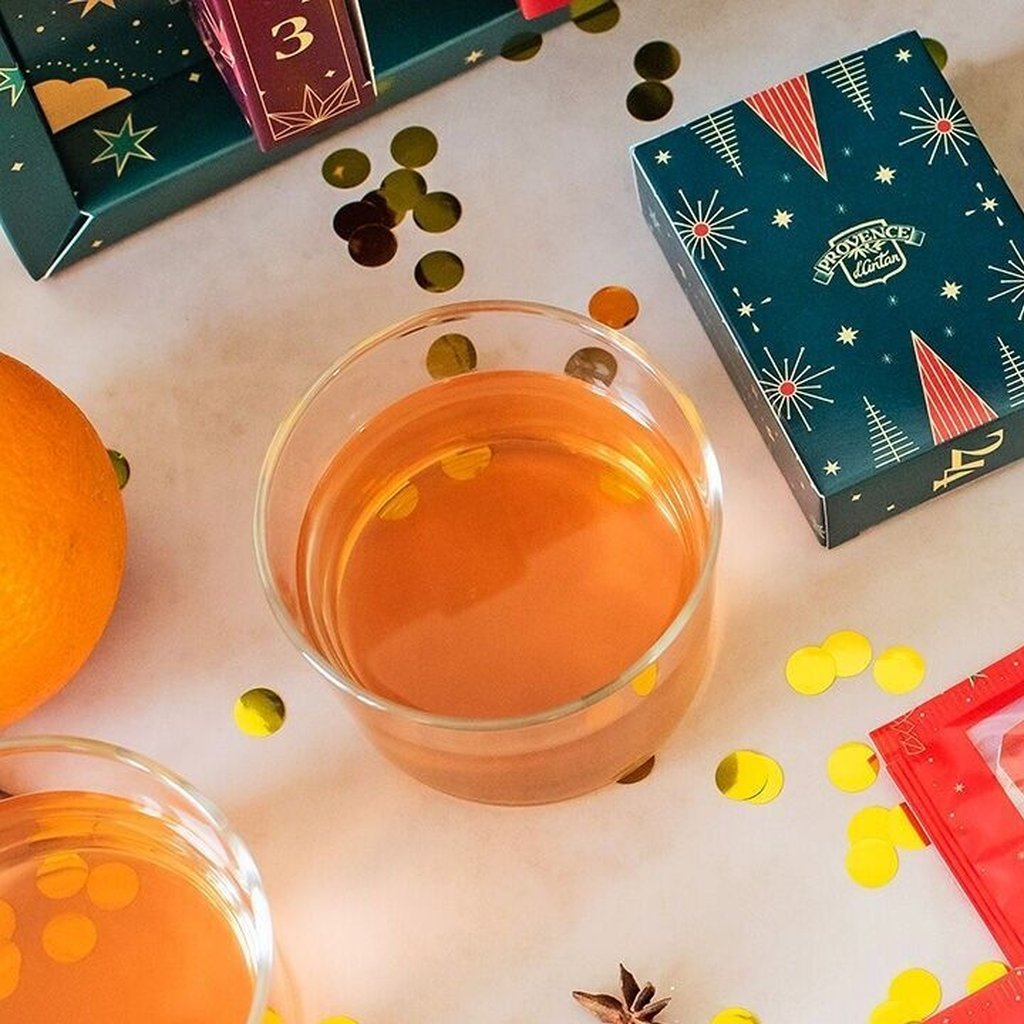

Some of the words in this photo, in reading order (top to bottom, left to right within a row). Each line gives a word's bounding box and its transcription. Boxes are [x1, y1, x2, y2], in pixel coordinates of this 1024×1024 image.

[271, 16, 315, 61] 3
[818, 225, 912, 271] PROVENCE
[932, 428, 1004, 492] 24
